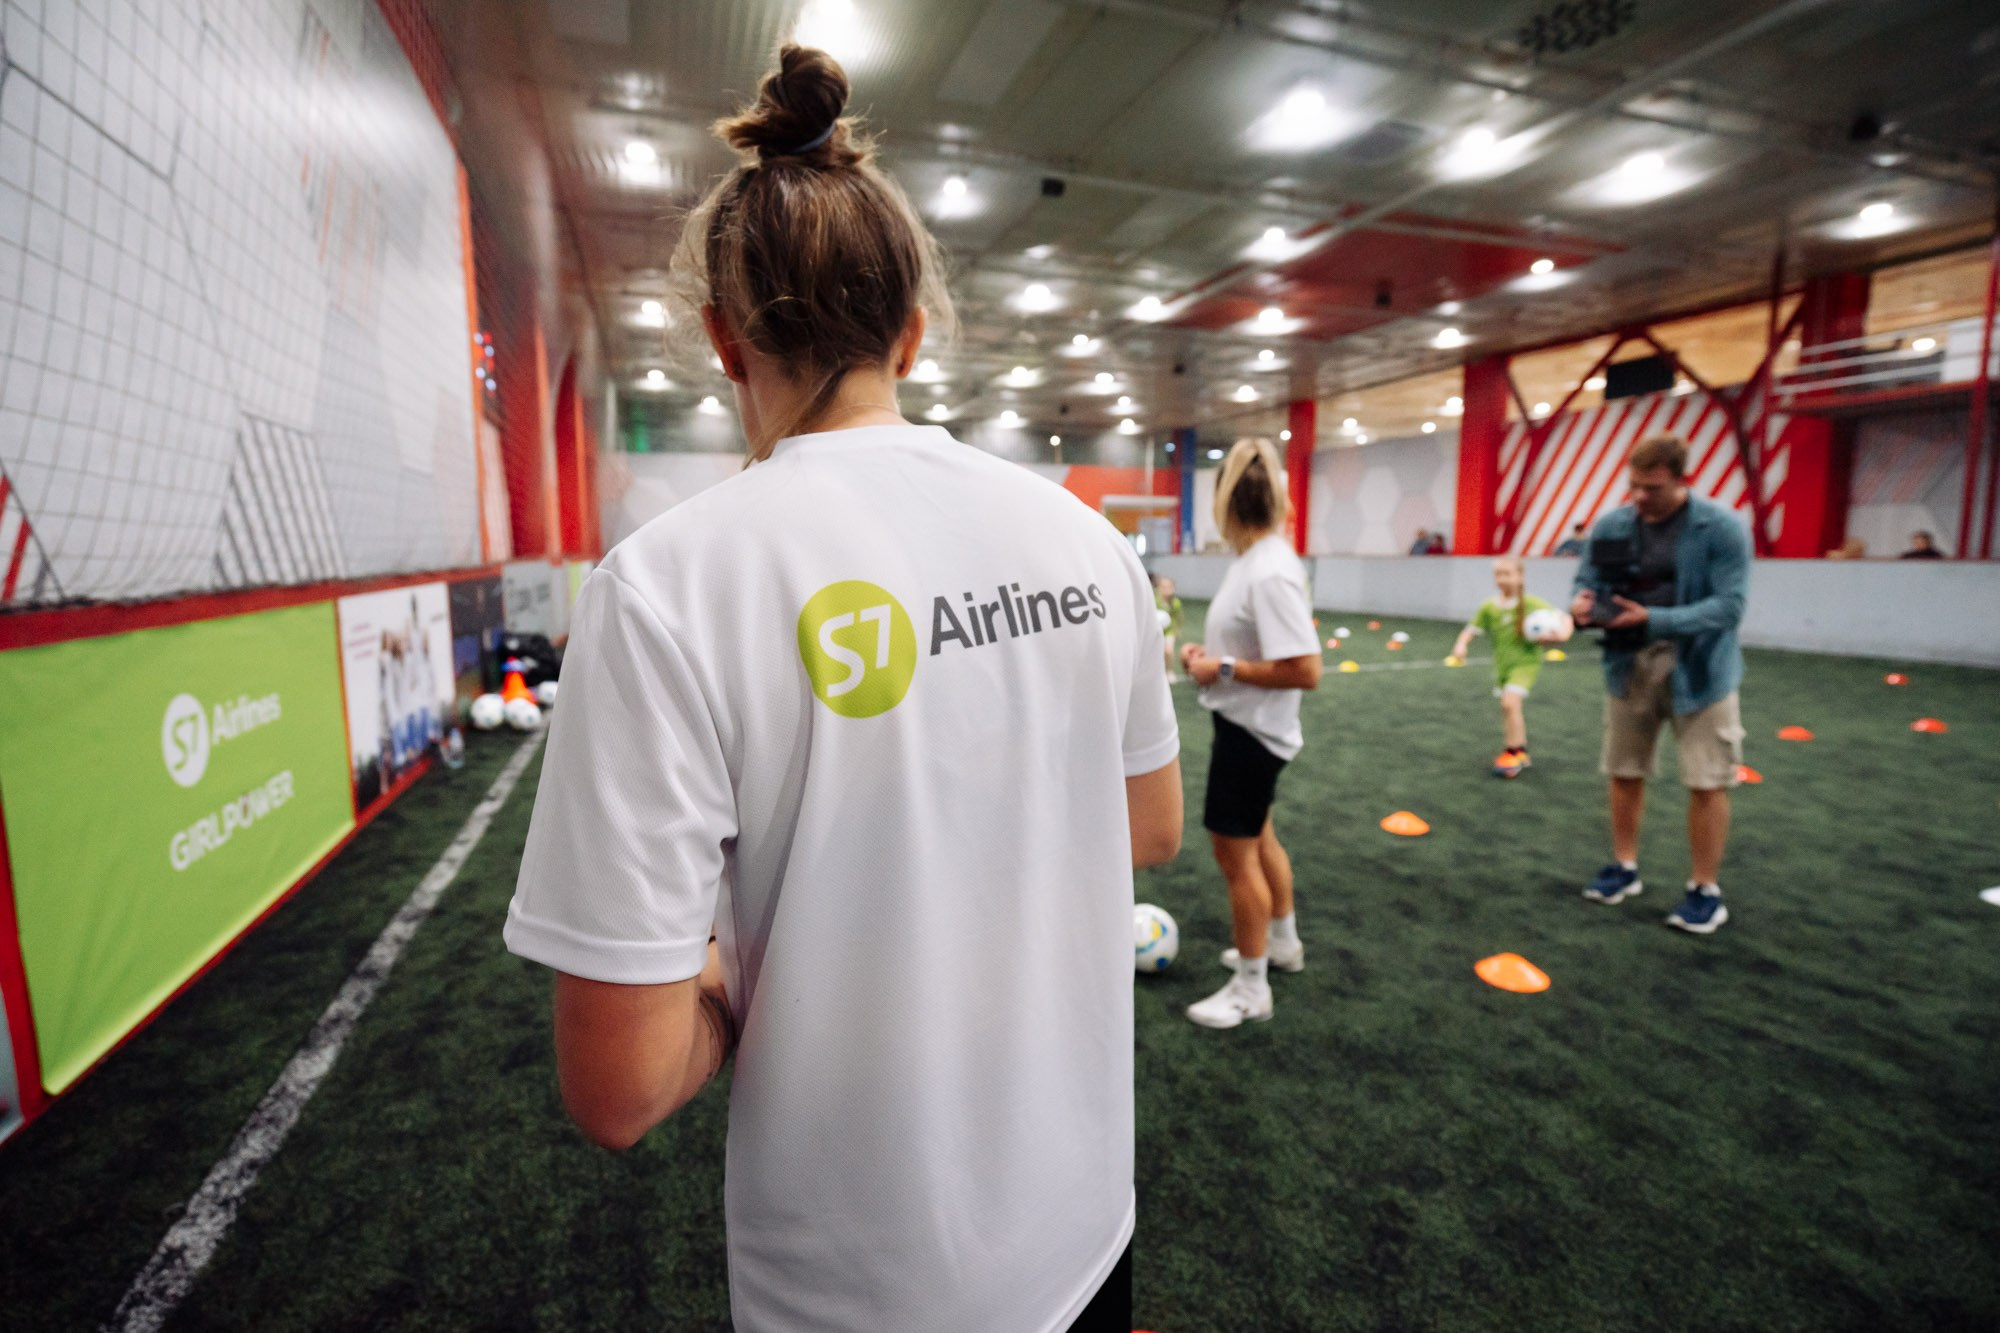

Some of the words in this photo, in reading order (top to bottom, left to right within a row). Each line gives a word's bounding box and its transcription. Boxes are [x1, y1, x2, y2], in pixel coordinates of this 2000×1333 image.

[818, 603, 892, 698] S7
[929, 582, 1107, 657] Airlines
[211, 691, 282, 745] Airlines
